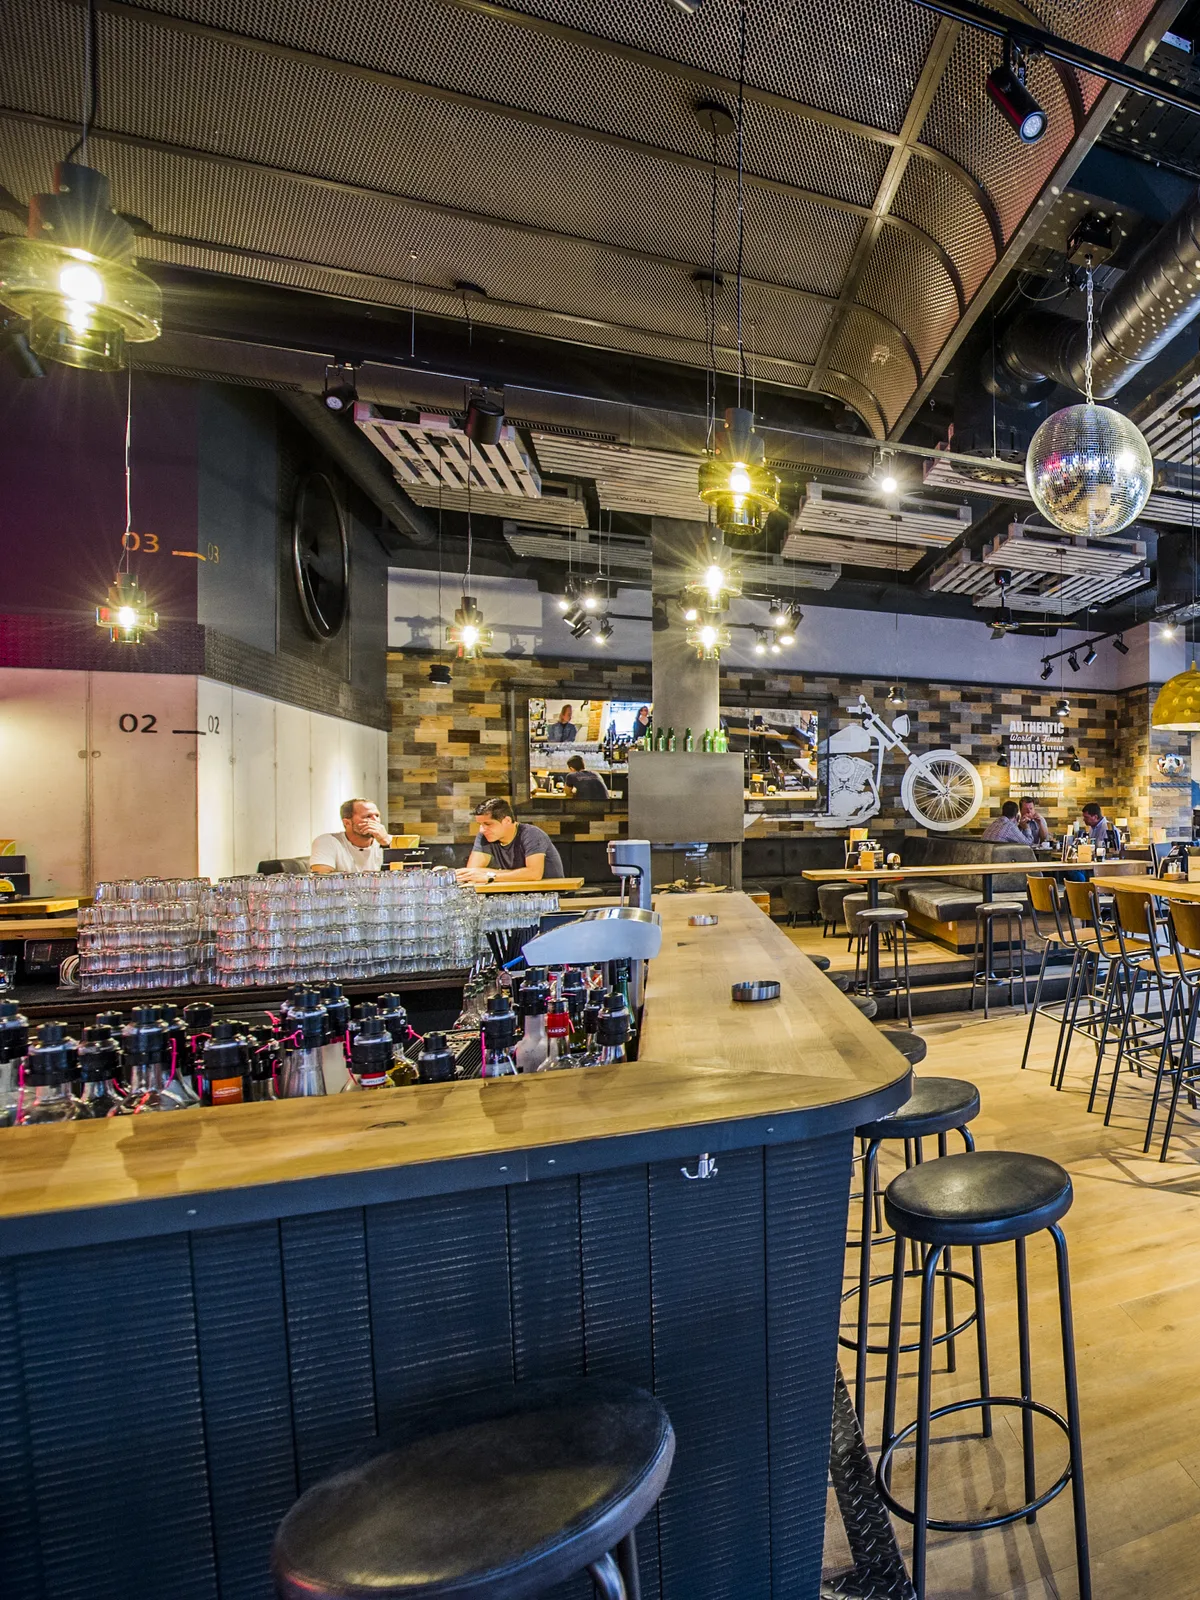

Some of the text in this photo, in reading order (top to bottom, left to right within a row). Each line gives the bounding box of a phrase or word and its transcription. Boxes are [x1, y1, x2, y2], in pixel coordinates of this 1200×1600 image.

[121, 532, 160, 553] 03
[119, 713, 158, 734] 02
[207, 714, 220, 735] 02
[1010, 721, 1064, 734] AUTHENTIC
[1010, 750, 1064, 769] HARLEY-
[1009, 768, 1064, 783] DAVIDSON
